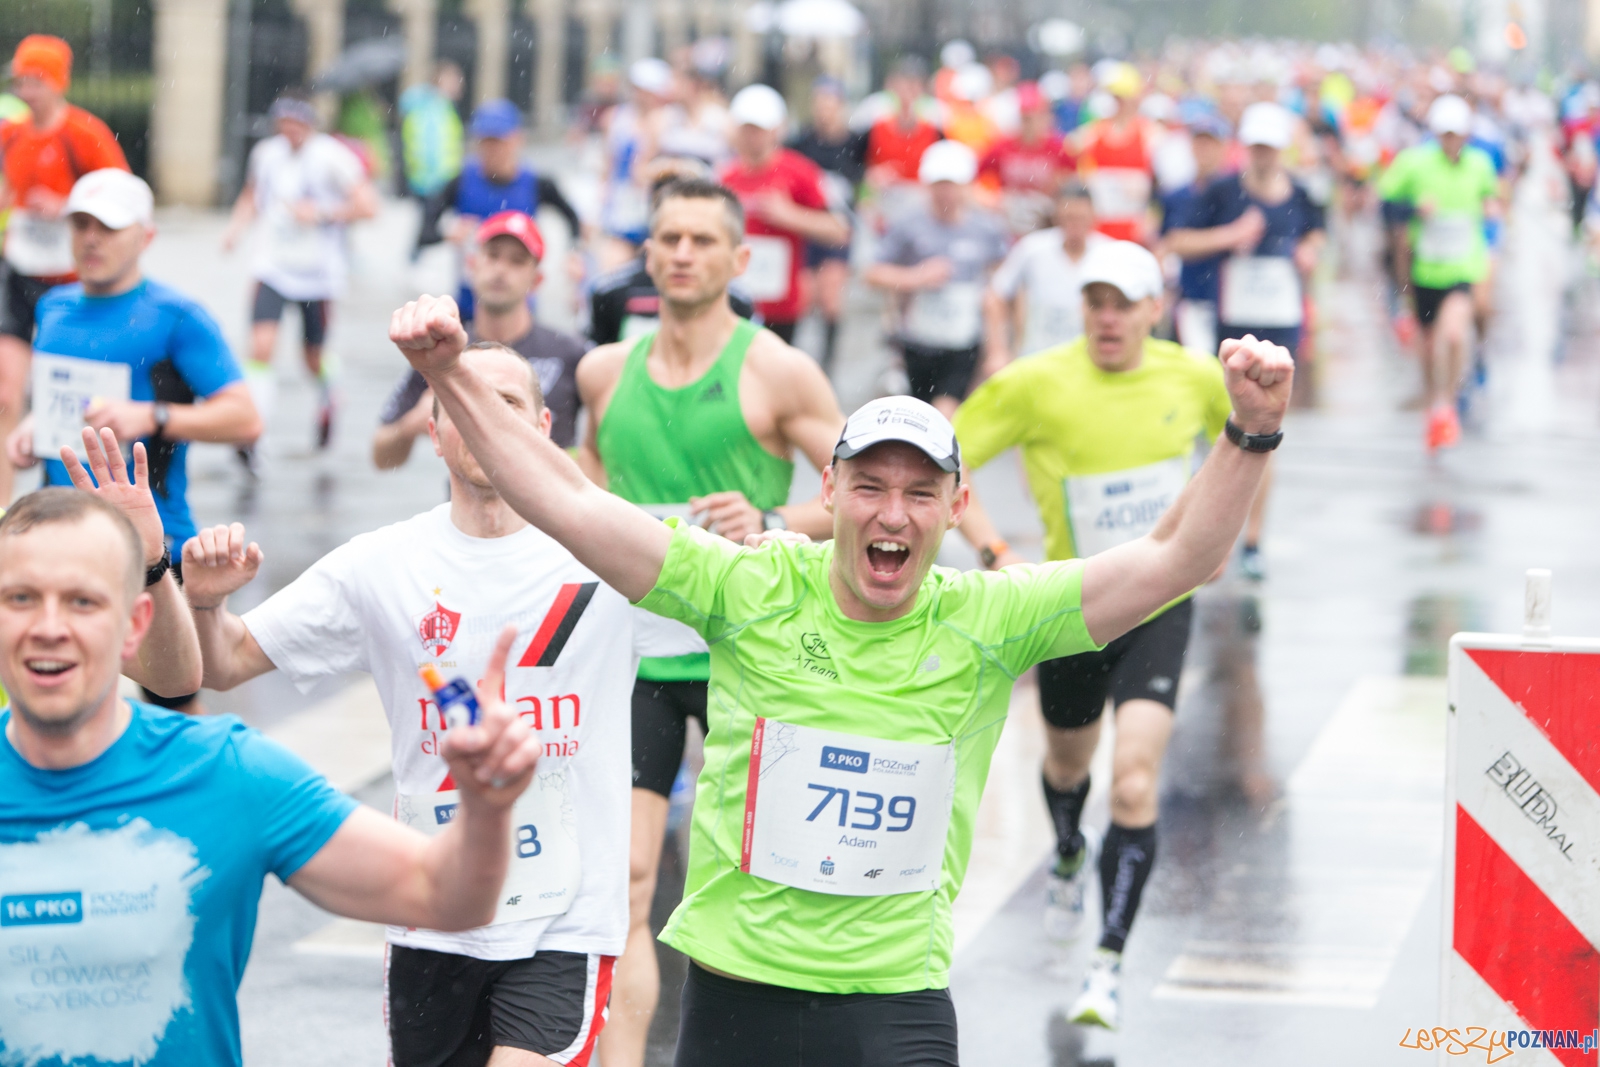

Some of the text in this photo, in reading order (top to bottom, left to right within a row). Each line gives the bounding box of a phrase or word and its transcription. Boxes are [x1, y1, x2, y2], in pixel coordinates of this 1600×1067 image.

[803, 658, 839, 681] Team
[805, 782, 917, 832] 7139
[838, 834, 878, 850] Adam
